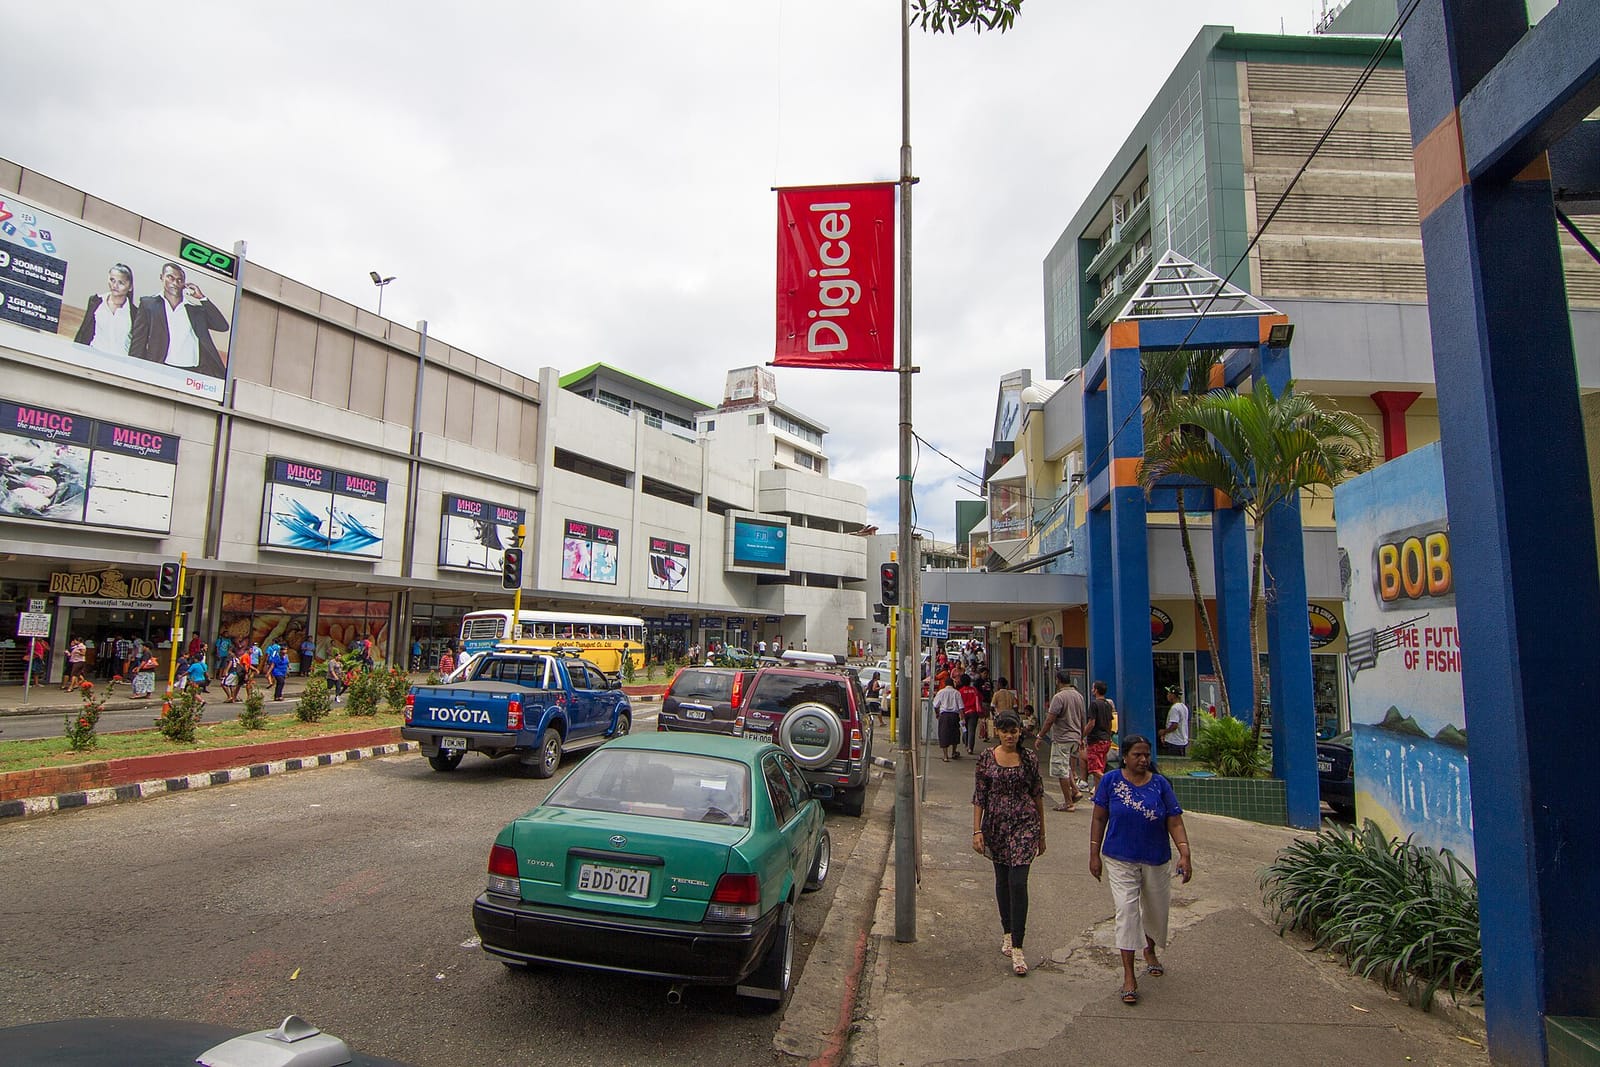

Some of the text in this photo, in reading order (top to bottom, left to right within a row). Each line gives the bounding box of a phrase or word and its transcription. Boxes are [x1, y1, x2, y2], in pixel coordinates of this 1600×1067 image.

[12, 258, 64, 280] 300MB Data
[808, 202, 861, 353] Digicel
[8, 296, 26, 307] 1GB
[27, 302, 47, 313] Data
[186, 378, 216, 392] Digicel
[17, 407, 73, 432] MHCC
[17, 421, 71, 439] the meeting point
[113, 427, 162, 449] MHCC
[113, 438, 161, 456] the meeting point
[287, 463, 322, 481] MHCC
[346, 476, 377, 492] MHCC
[457, 499, 481, 512] MHCC
[497, 507, 518, 520] MHCC
[569, 523, 587, 534] MHCC
[597, 528, 614, 538] MHCC
[1379, 532, 1451, 602] BOB
[49, 572, 100, 595] BREAD
[1394, 628, 1419, 648] THE
[1404, 650, 1419, 671] OF
[429, 707, 491, 724] TOYOTA
[527, 859, 554, 868] TOYOTA
[671, 877, 709, 887] TERCEL
